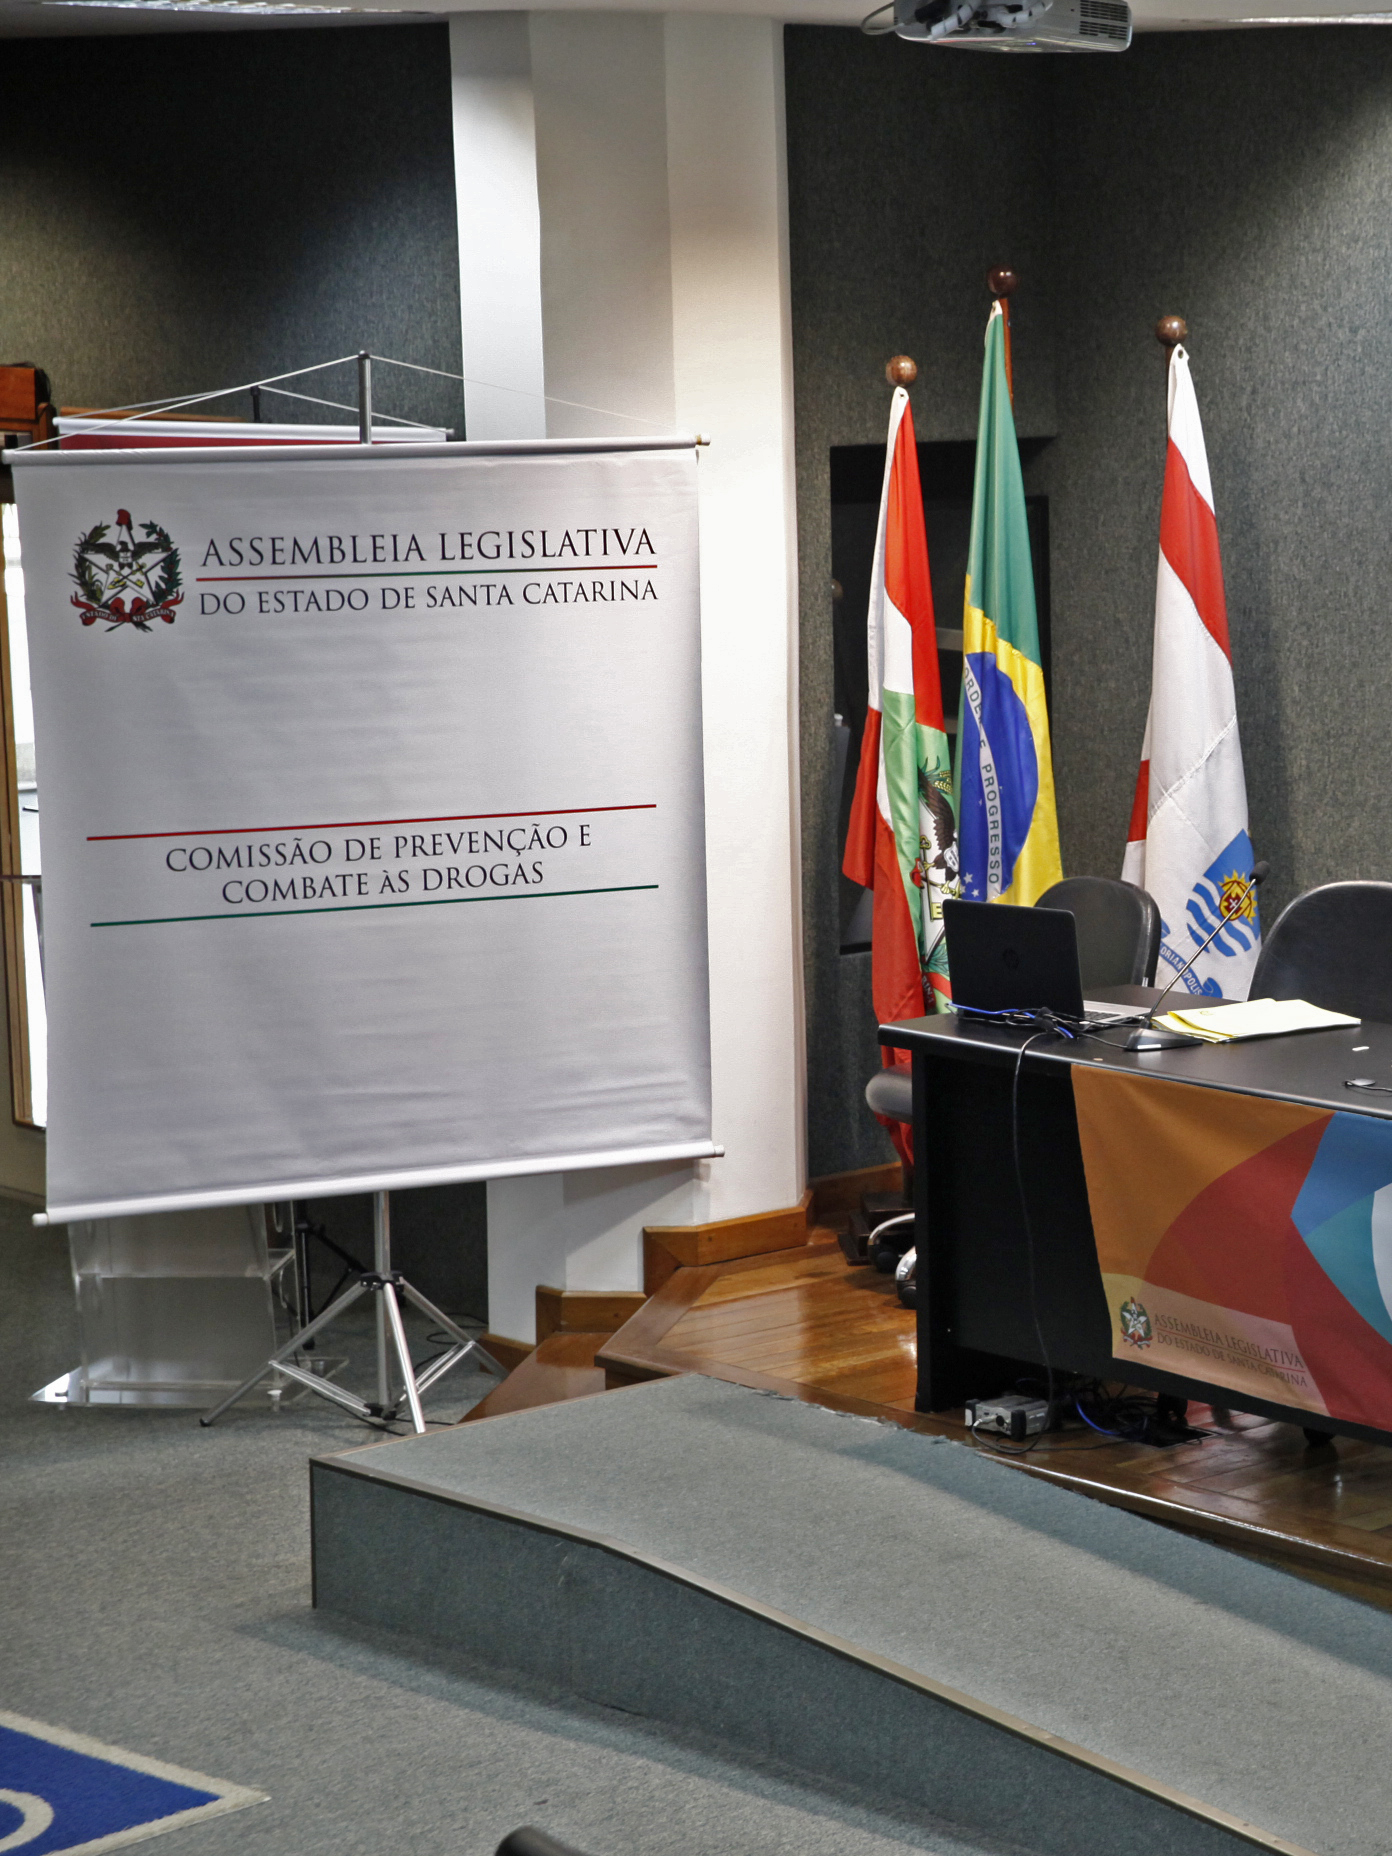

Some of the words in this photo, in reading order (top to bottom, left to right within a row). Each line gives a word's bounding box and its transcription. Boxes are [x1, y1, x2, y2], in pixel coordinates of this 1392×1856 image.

[200, 533, 428, 567] ASSEMBLEIA
[438, 527, 657, 561] LEGISLATIVA
[199, 591, 246, 616] DO
[257, 587, 369, 614] ESTADO
[380, 586, 416, 610] DE
[426, 582, 515, 609] SANTA
[522, 578, 659, 606] CATARINA
[964, 667, 982, 724] ORDE
[981, 763, 1000, 884] PROGRESSO
[165, 837, 333, 872] COMISSÃO
[344, 837, 382, 862] DE
[394, 823, 568, 858] PREVENÇÃO
[579, 824, 592, 847] E
[221, 872, 370, 904] COMBATE
[378, 869, 410, 894] ÀS
[422, 861, 544, 892] DROGAS
[1154, 1314, 1224, 1346] ASSEMBLEIA
[1225, 1334, 1305, 1369] LEGISLATIVA
[1157, 1332, 1173, 1345] DO
[1175, 1337, 1211, 1357] ESTADO
[1212, 1348, 1226, 1361] DE
[1227, 1354, 1256, 1370] SANTA
[1257, 1362, 1308, 1388] CATARINA
